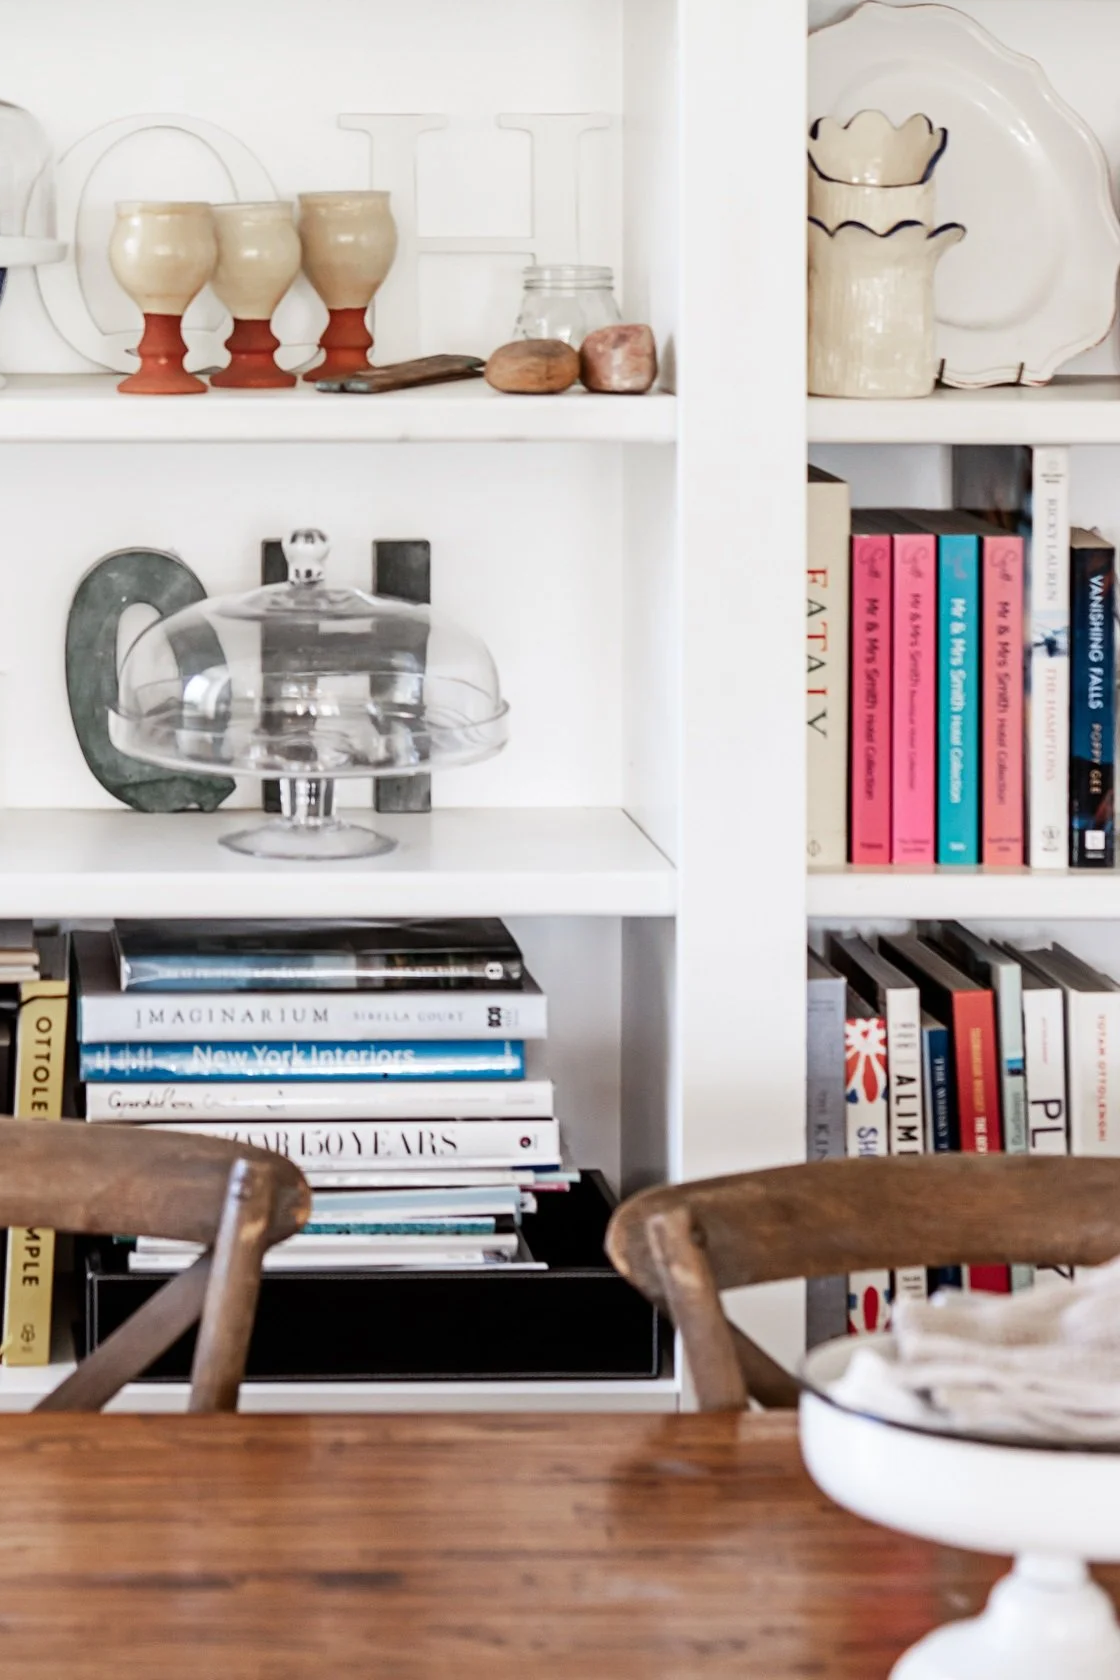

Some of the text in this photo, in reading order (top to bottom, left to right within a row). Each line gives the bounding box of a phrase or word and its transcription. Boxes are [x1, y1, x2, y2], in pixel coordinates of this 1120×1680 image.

[1046, 498, 1059, 540] RICKY
[1046, 544, 1059, 601] LAUREN
[909, 593, 922, 608] Mr
[950, 598, 966, 618] Mr
[909, 624, 922, 646] Mrs
[950, 622, 966, 634] &
[909, 650, 922, 687] Smith
[950, 638, 966, 665] Mrs
[865, 598, 881, 800] Mr & Mrs Smith Hotel Collection
[950, 669, 967, 711] Smith
[997, 601, 1012, 804] Mr & Mrs Smith Hotel Collection
[1087, 575, 1105, 795] VANISHING FALLS POPPY GEE
[950, 715, 964, 745] Hotel
[1045, 668, 1057, 781] THE HAMPTONS
[950, 748, 964, 803] Collection
[136, 1007, 329, 1028] IMAGINARIUM
[417, 1010, 465, 1022] COURT
[32, 1016, 52, 1111] OTTOLE
[192, 1041, 415, 1068] New York Interiors
[1097, 1062, 1107, 1142] OTTOLENGHI
[300, 1129, 344, 1157] 150
[351, 1129, 458, 1158] YEARS
[22, 1227, 41, 1286] MPLE
